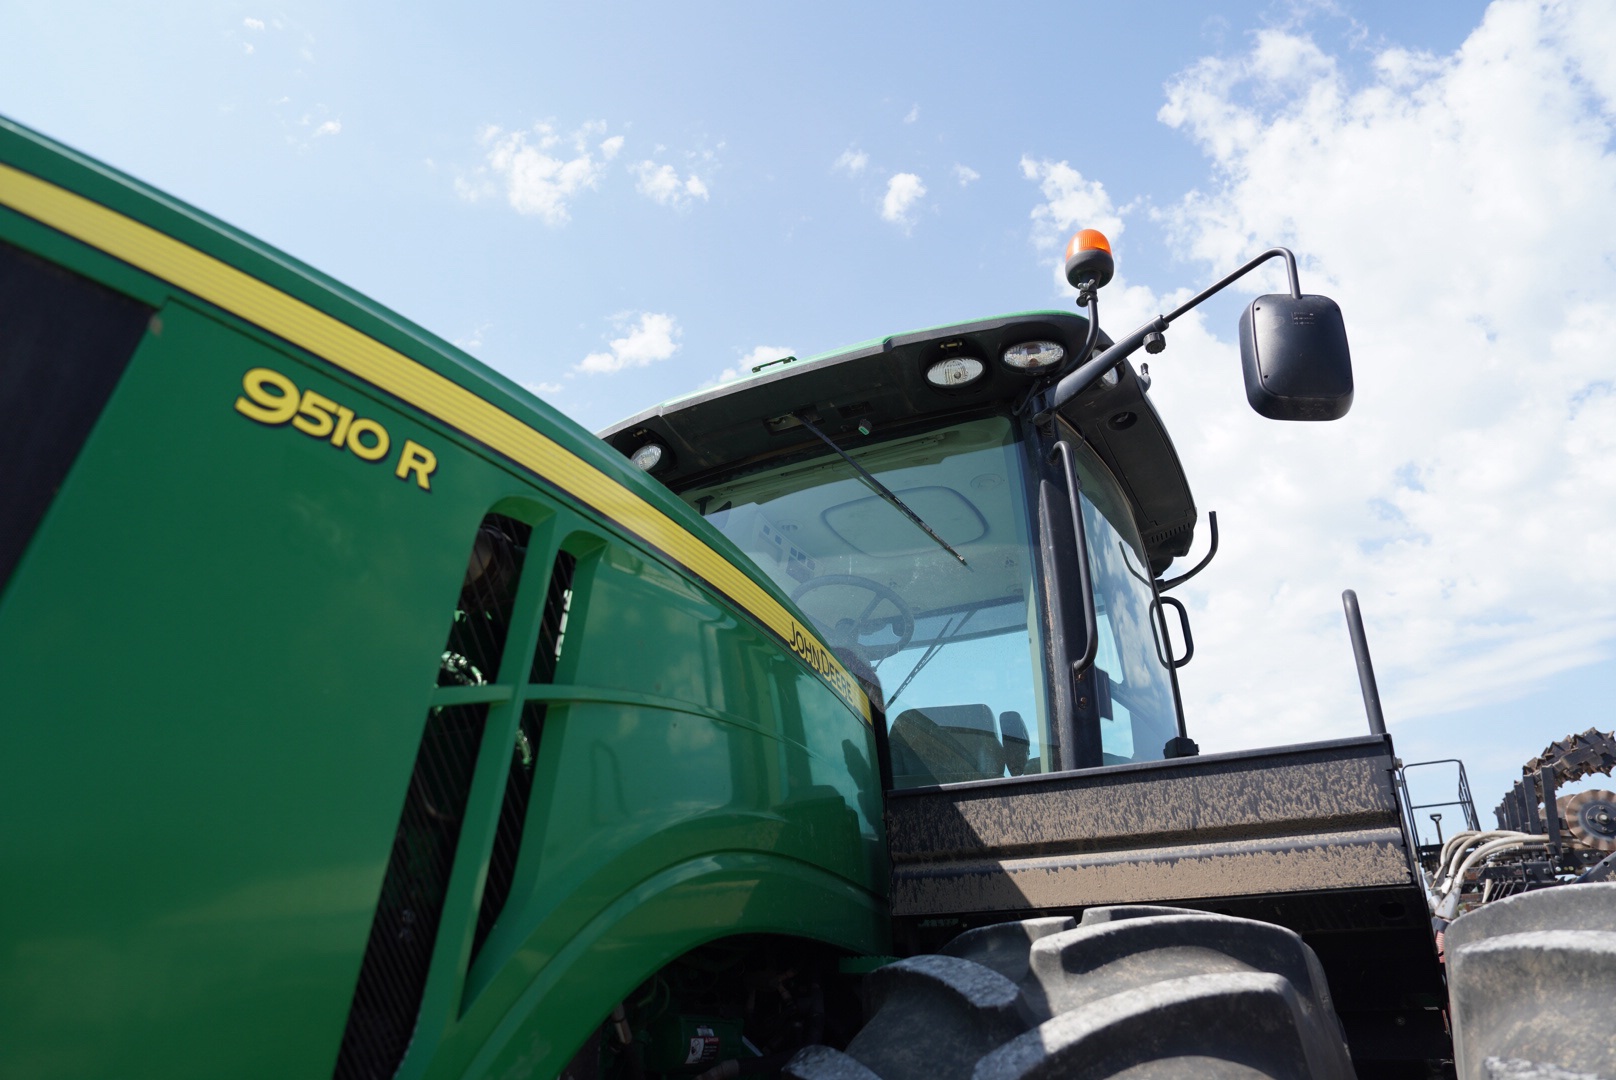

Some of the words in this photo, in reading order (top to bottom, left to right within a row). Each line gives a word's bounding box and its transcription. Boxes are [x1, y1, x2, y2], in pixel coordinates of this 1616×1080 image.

[234, 367, 391, 462] 9510
[395, 438, 438, 491] R
[790, 621, 820, 670] JOHN
[820, 648, 854, 704] DEERE
